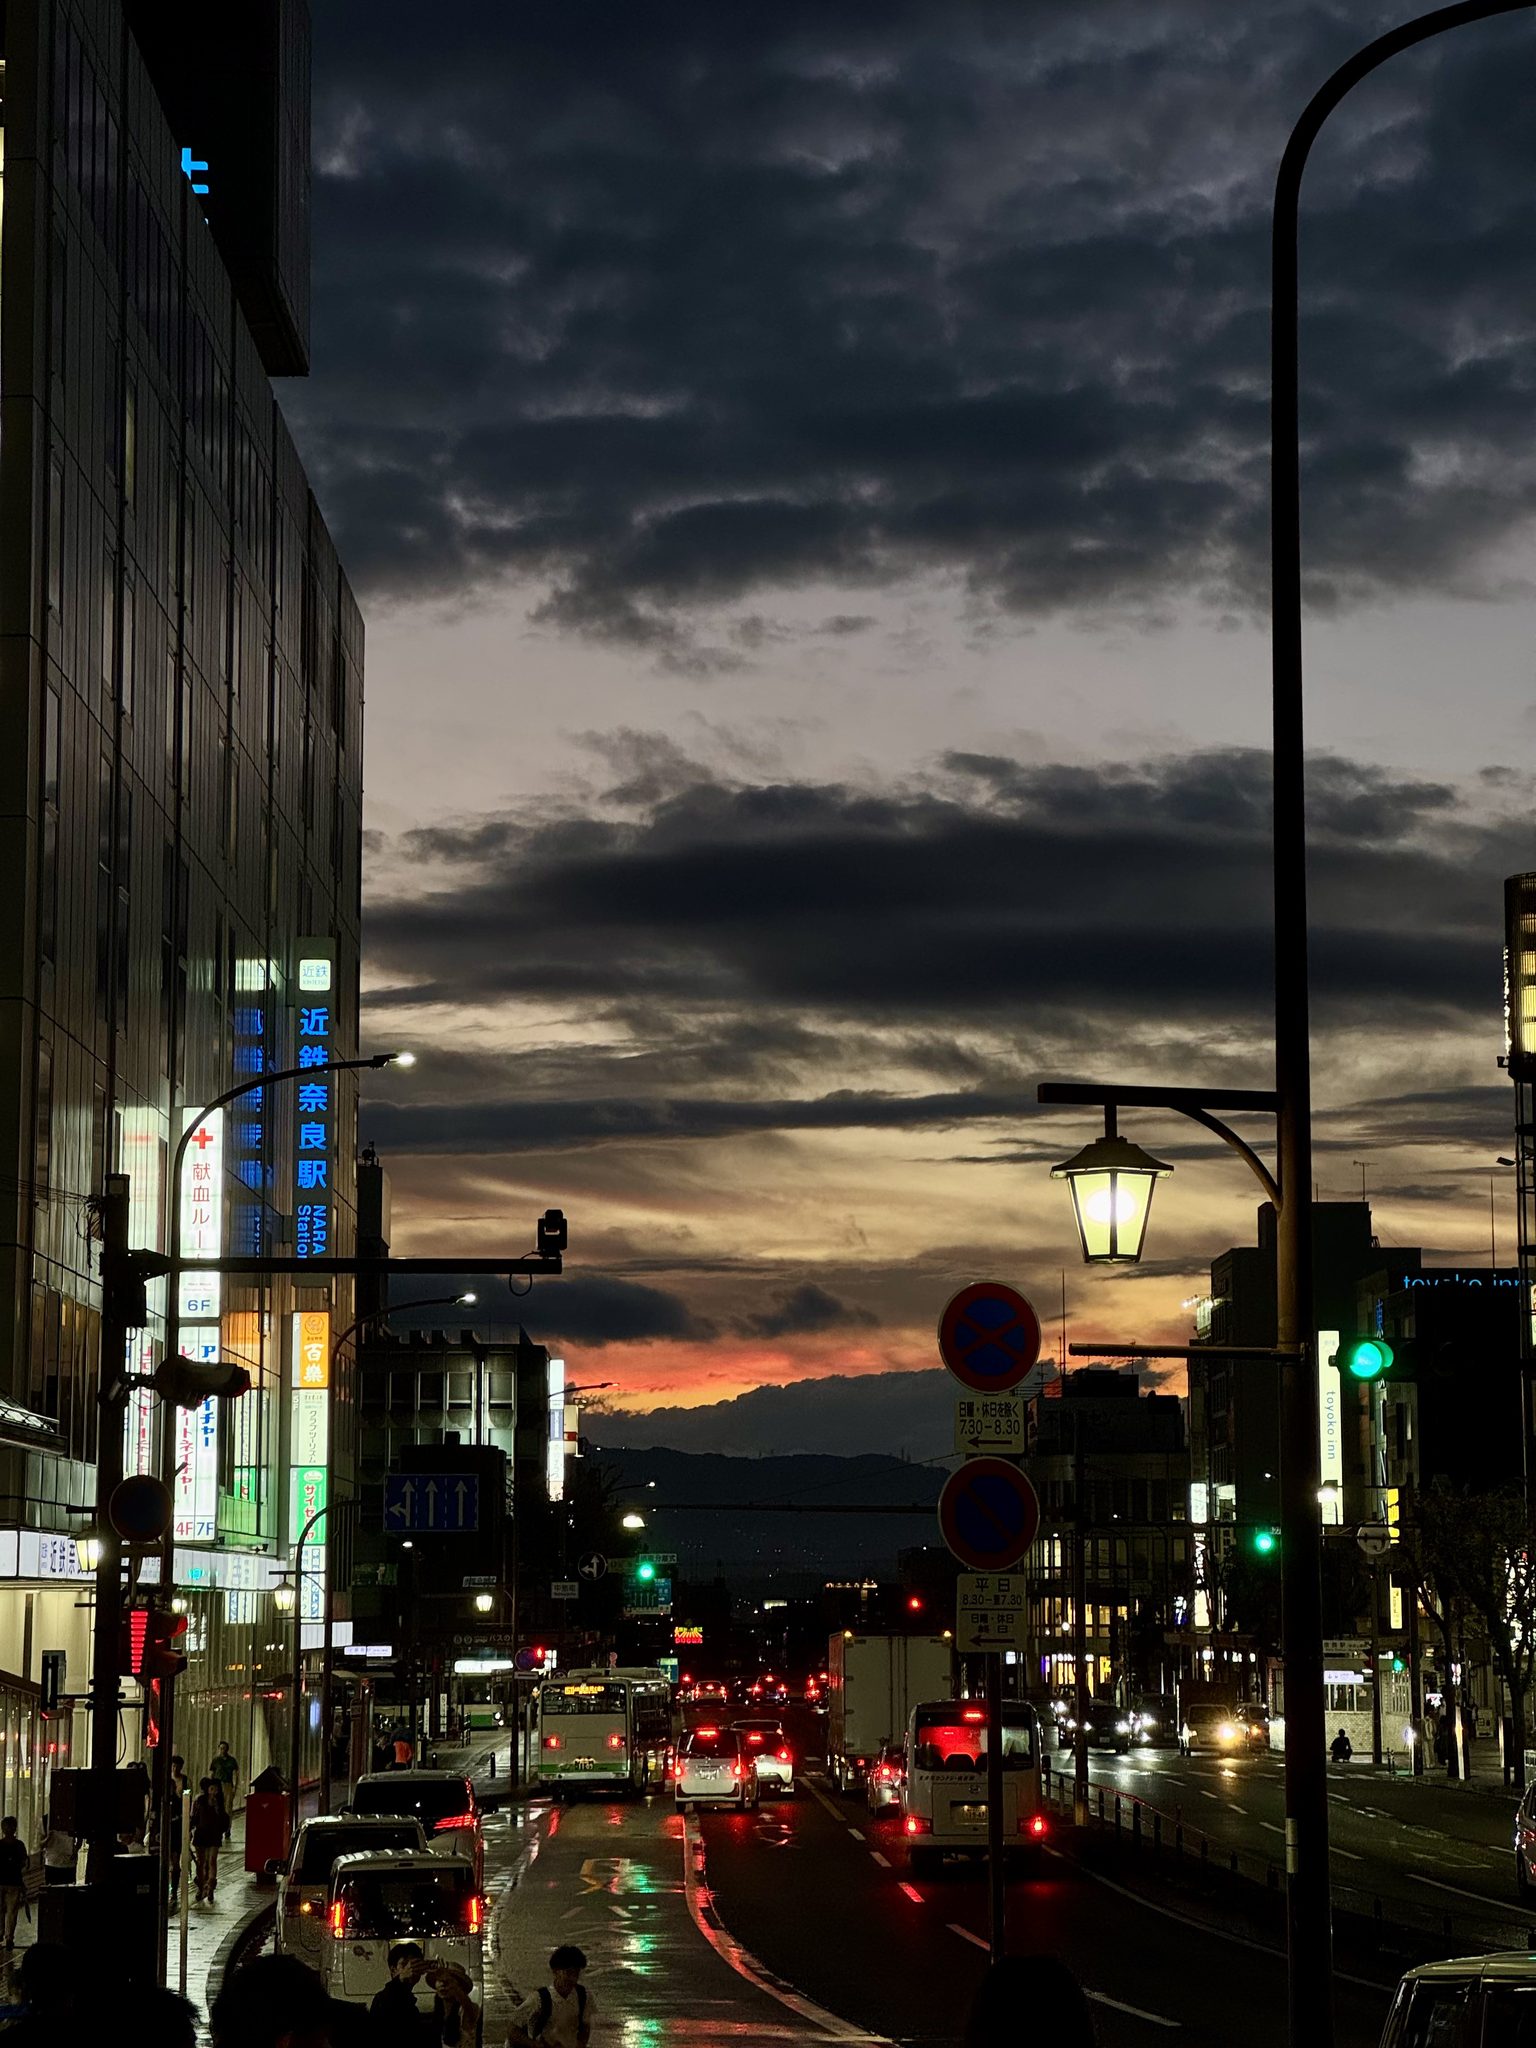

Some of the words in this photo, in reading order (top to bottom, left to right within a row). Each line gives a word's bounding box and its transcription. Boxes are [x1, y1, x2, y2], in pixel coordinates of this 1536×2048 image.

[302, 965, 328, 977] 近鉄
[298, 1007, 329, 1189] 近鉄奈良駅
[191, 1162, 211, 1258] 献血ルー
[312, 1204, 327, 1255] NARA
[187, 1299, 211, 1311] 6F
[200, 1345, 217, 1448] アイチャー
[959, 1401, 1019, 1418] 日曜・休日を除く
[1325, 1391, 1336, 1436] toyoko
[1327, 1439, 1337, 1461] inn
[175, 1522, 193, 1536] 4F
[197, 1522, 214, 1536] 7F
[971, 1613, 1014, 1624] 日曜・休日
